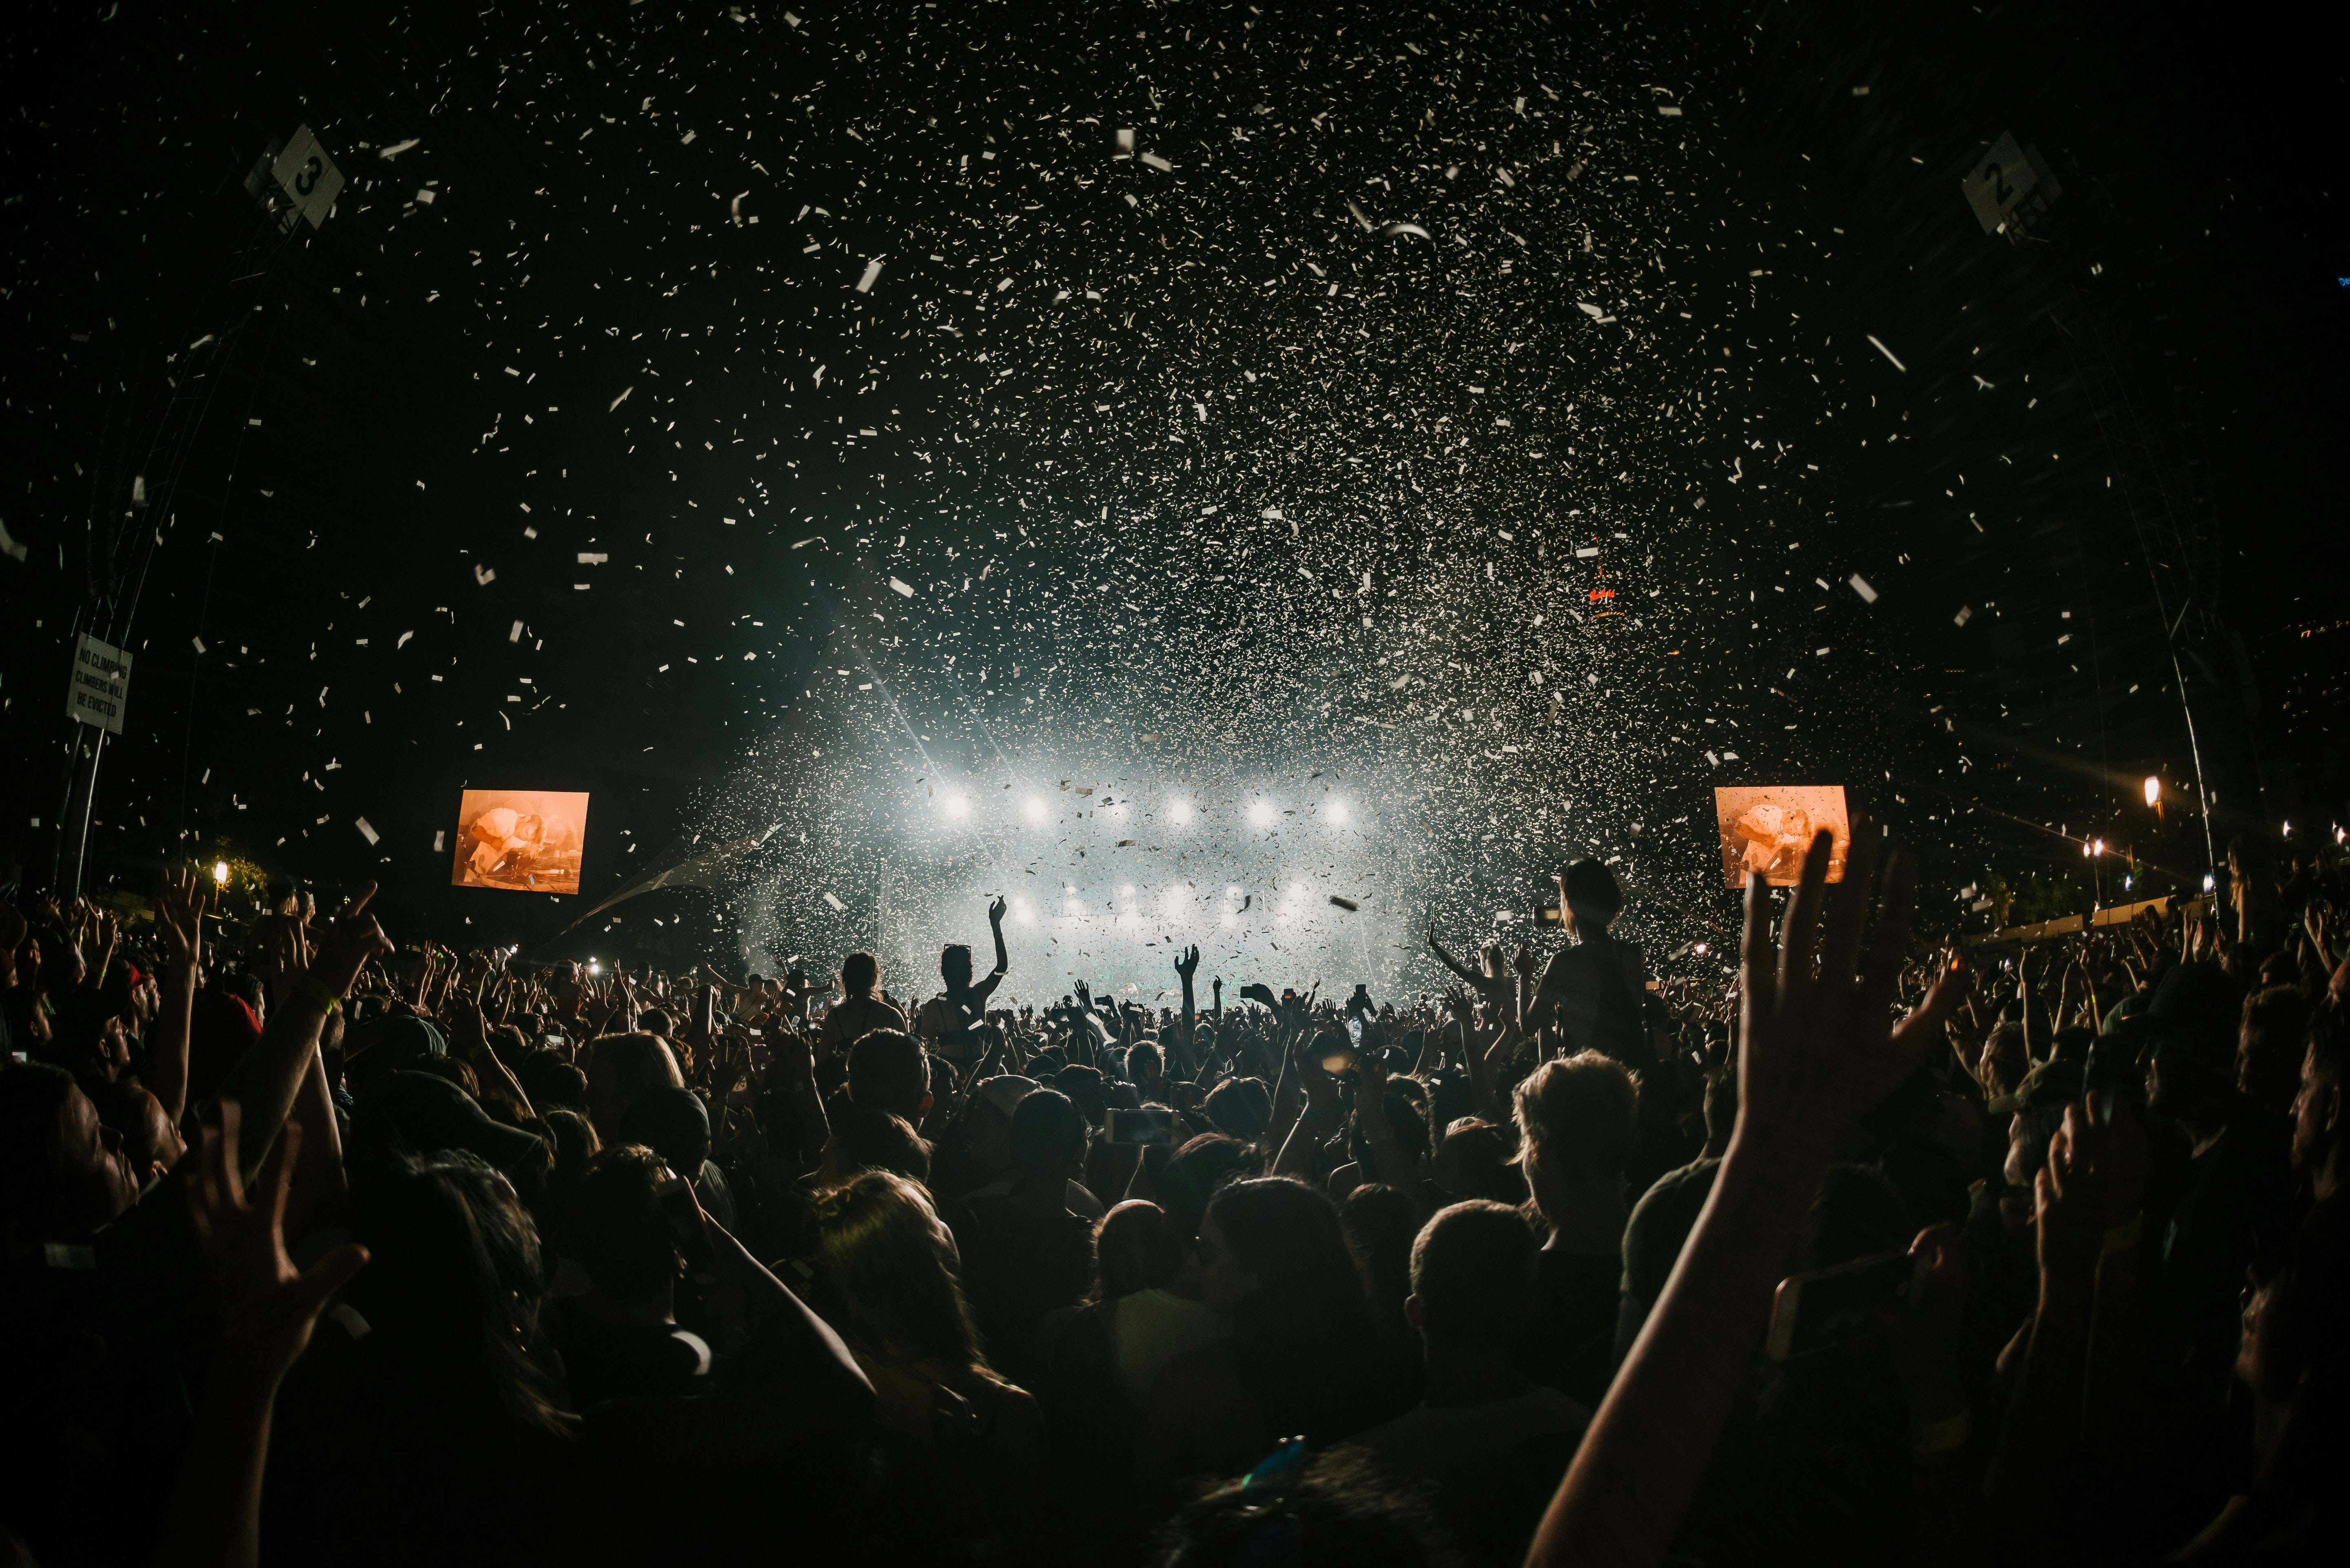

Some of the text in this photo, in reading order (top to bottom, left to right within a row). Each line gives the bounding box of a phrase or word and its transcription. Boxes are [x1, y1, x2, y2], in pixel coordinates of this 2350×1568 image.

[295, 157, 322, 196] 3
[1985, 162, 2013, 205] 2
[2339, 277, 2350, 286] De
[80, 648, 127, 679] NO CLIMBING
[76, 671, 123, 699] CLIMBERS WILL
[77, 691, 117, 717] BE EVICTED
